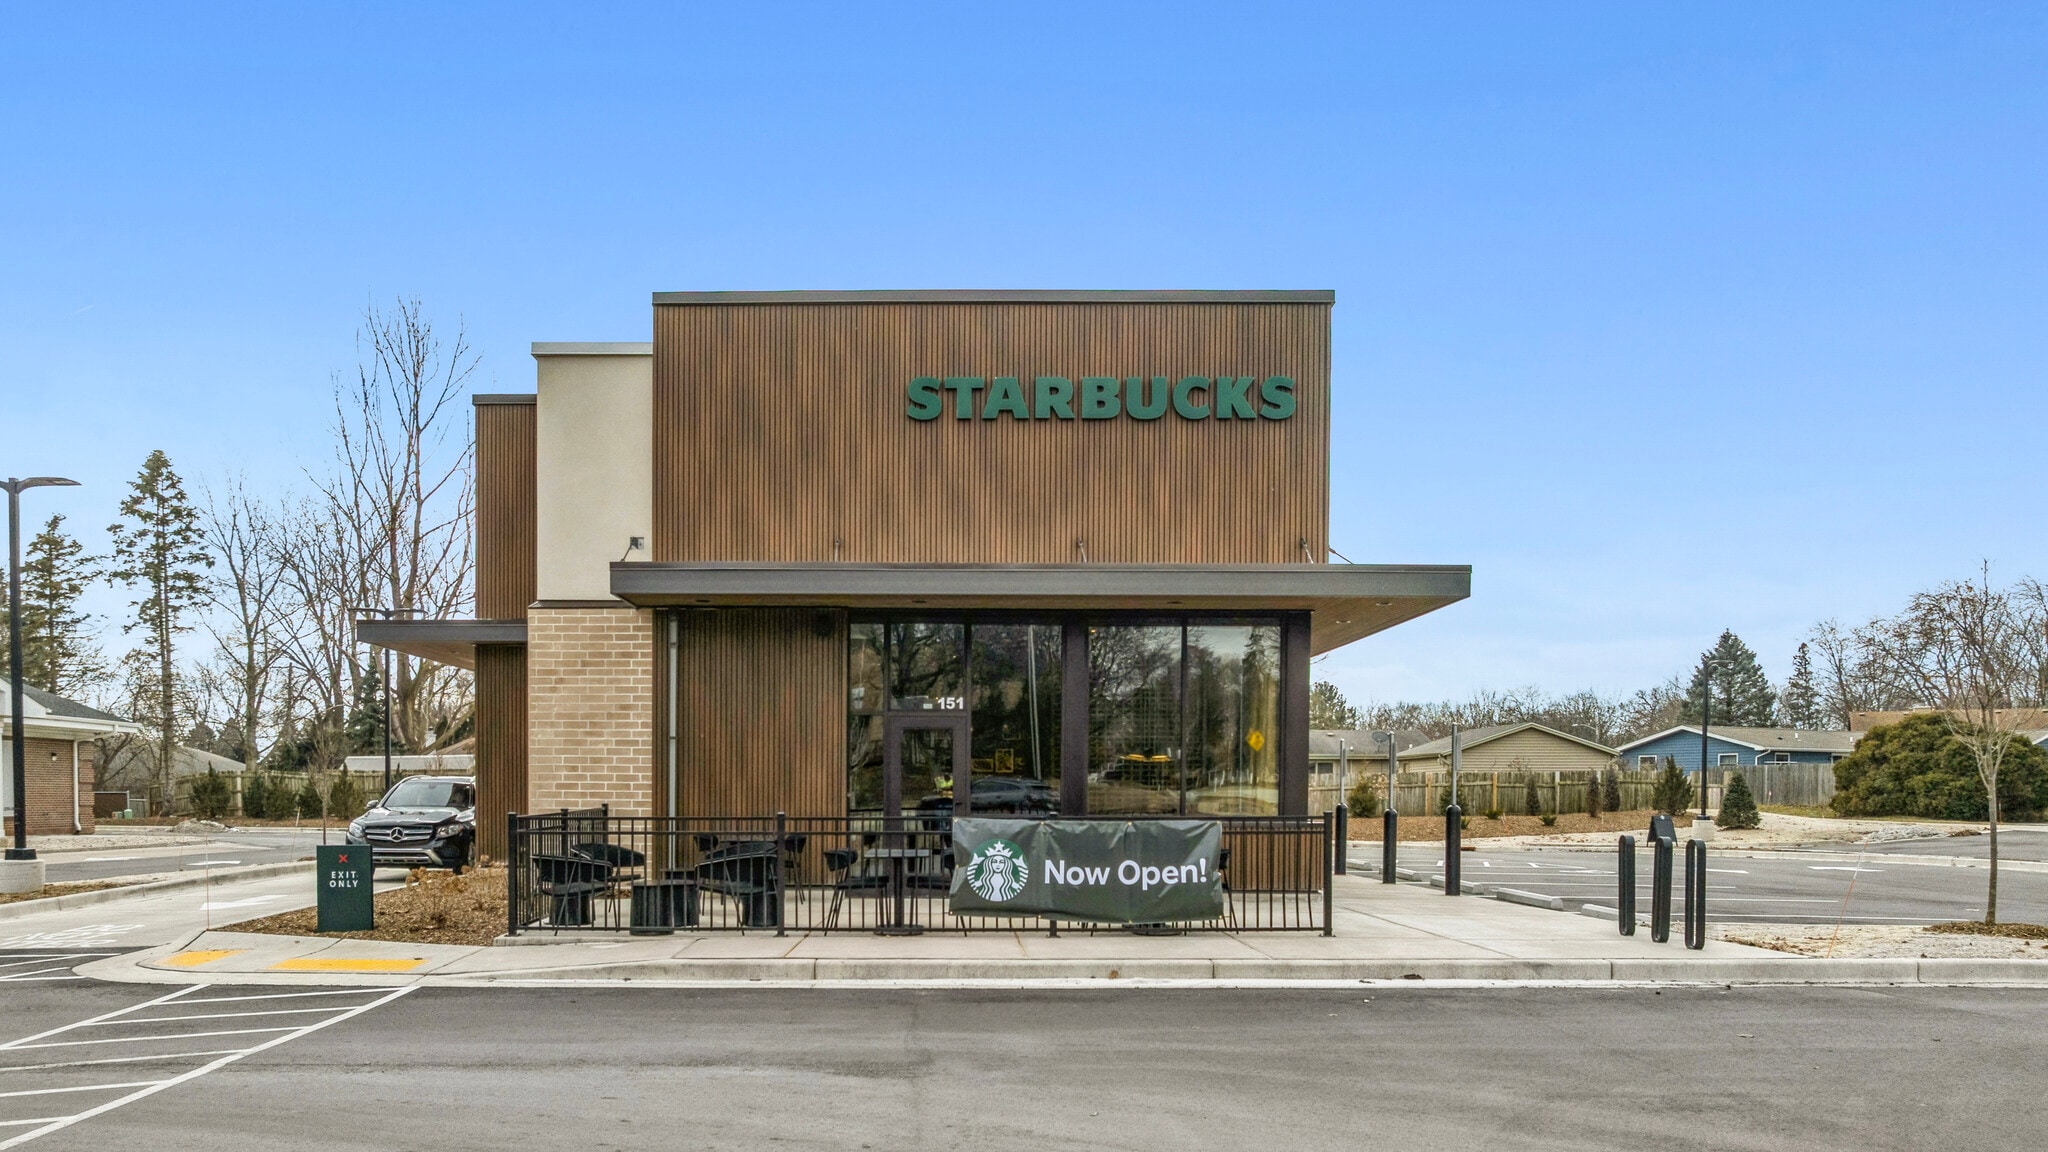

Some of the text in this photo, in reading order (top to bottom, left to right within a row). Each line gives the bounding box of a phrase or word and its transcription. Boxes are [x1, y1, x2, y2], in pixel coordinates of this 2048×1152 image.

[907, 376, 1296, 420] STARBUCKS
[938, 697, 964, 709] 151
[331, 871, 357, 879] EXIT
[1044, 858, 1207, 891] Now Open!
[329, 880, 359, 888] ONLY
